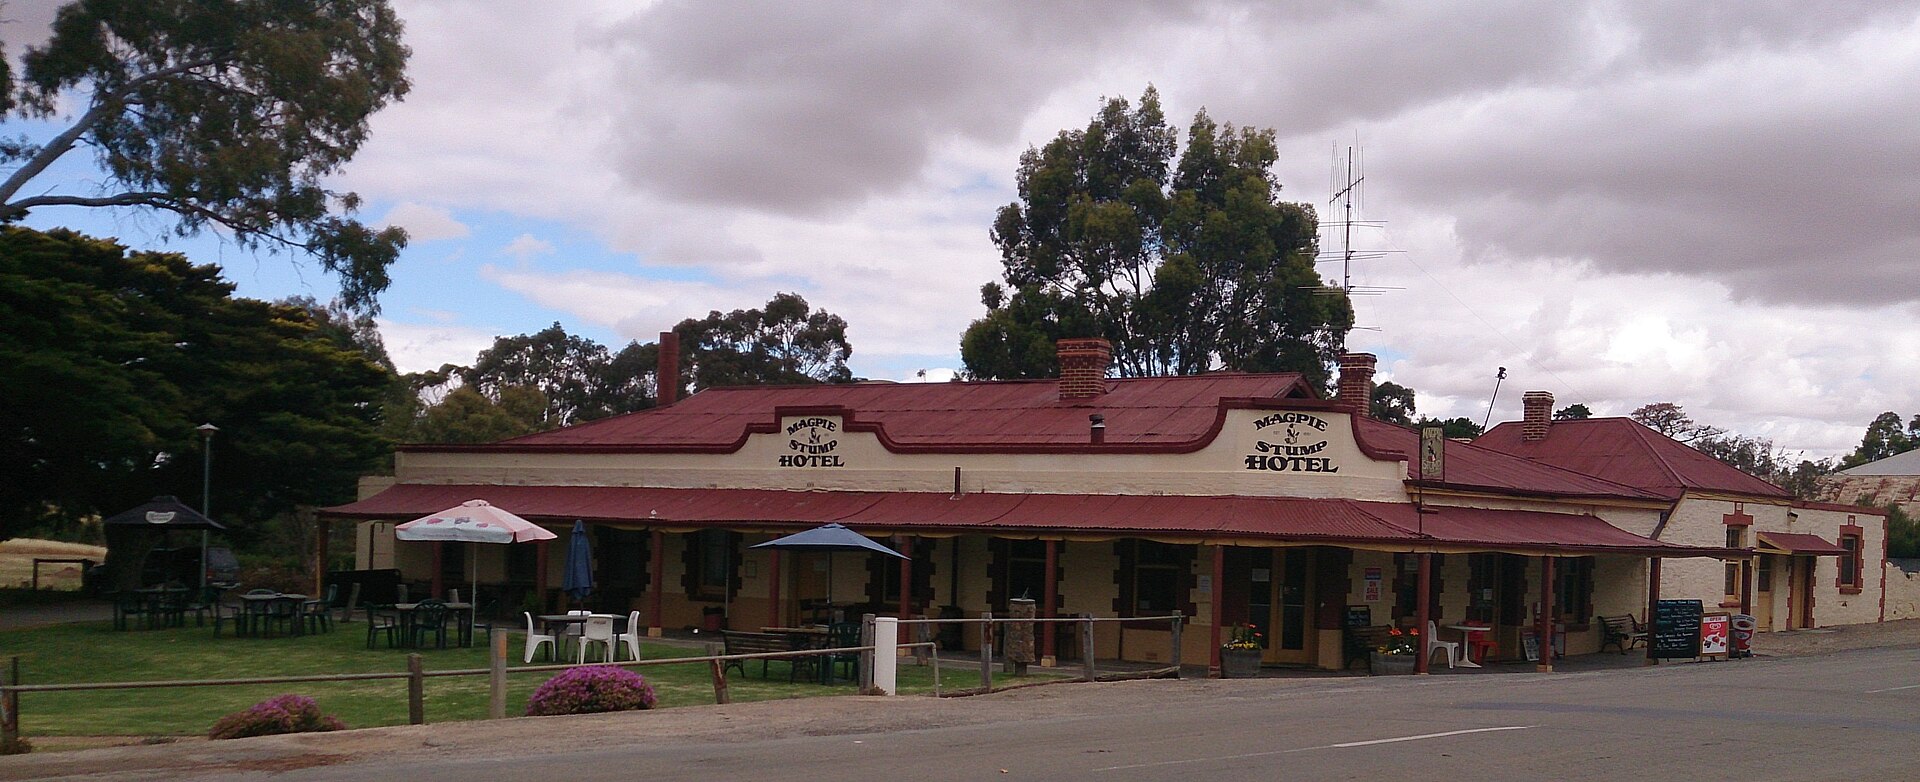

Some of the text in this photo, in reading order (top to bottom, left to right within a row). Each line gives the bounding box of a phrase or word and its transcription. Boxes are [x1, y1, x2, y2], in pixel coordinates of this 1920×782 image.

[786, 418, 837, 435] MAGPIE
[1253, 412, 1328, 431] MAGPIE
[789, 439, 838, 454] STUMP
[1255, 440, 1328, 455] STUMP
[779, 455, 845, 467] HOTEL
[1244, 455, 1339, 473] HOTEL
